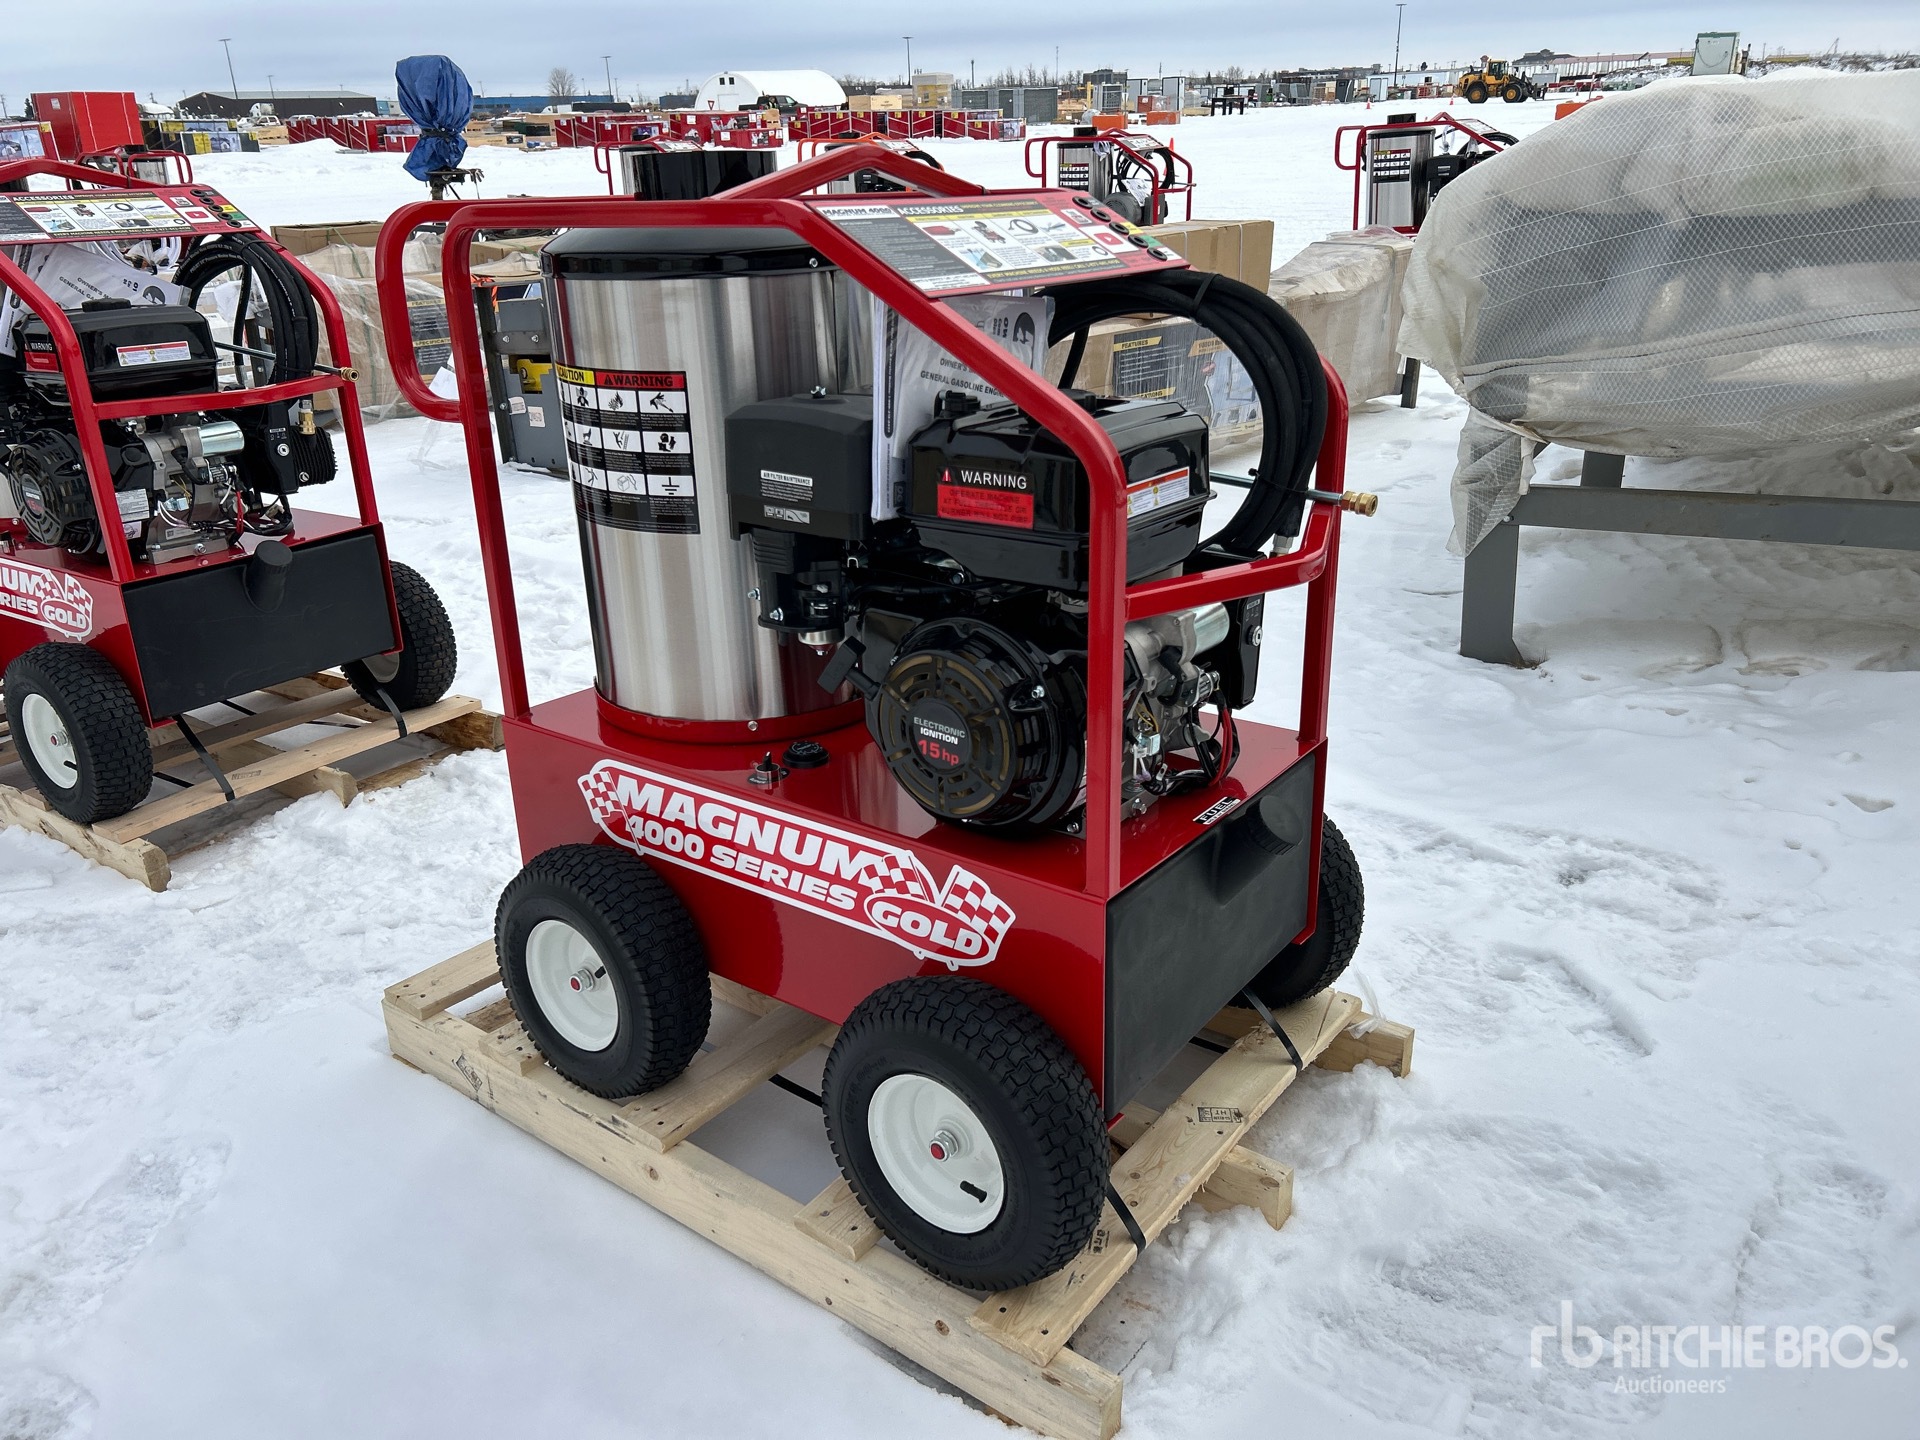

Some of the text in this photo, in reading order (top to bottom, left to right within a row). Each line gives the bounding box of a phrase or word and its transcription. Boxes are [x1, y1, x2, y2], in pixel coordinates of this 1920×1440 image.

[822, 207, 868, 216] MAGNUM
[897, 204, 965, 215] ACCESSORIES
[58, 275, 86, 296] GENERAL
[1121, 339, 1149, 350] FEATURES
[559, 364, 585, 383] CAUTION
[940, 357, 967, 372] OWNER'S
[613, 375, 674, 387] WARNING
[920, 370, 949, 386] GENERAL
[950, 377, 984, 393] GASOLINE
[961, 469, 1027, 490] WARNING
[949, 489, 985, 500] OPERATE
[43, 604, 87, 630] GOLD
[913, 716, 966, 739] ELECTRONIC
[920, 727, 958, 745] IGNITION
[1199, 799, 1233, 821] FUEL
[616, 773, 874, 885] MAGNUM
[625, 814, 858, 911] 4000 SERIES
[870, 900, 983, 956] GOLD
